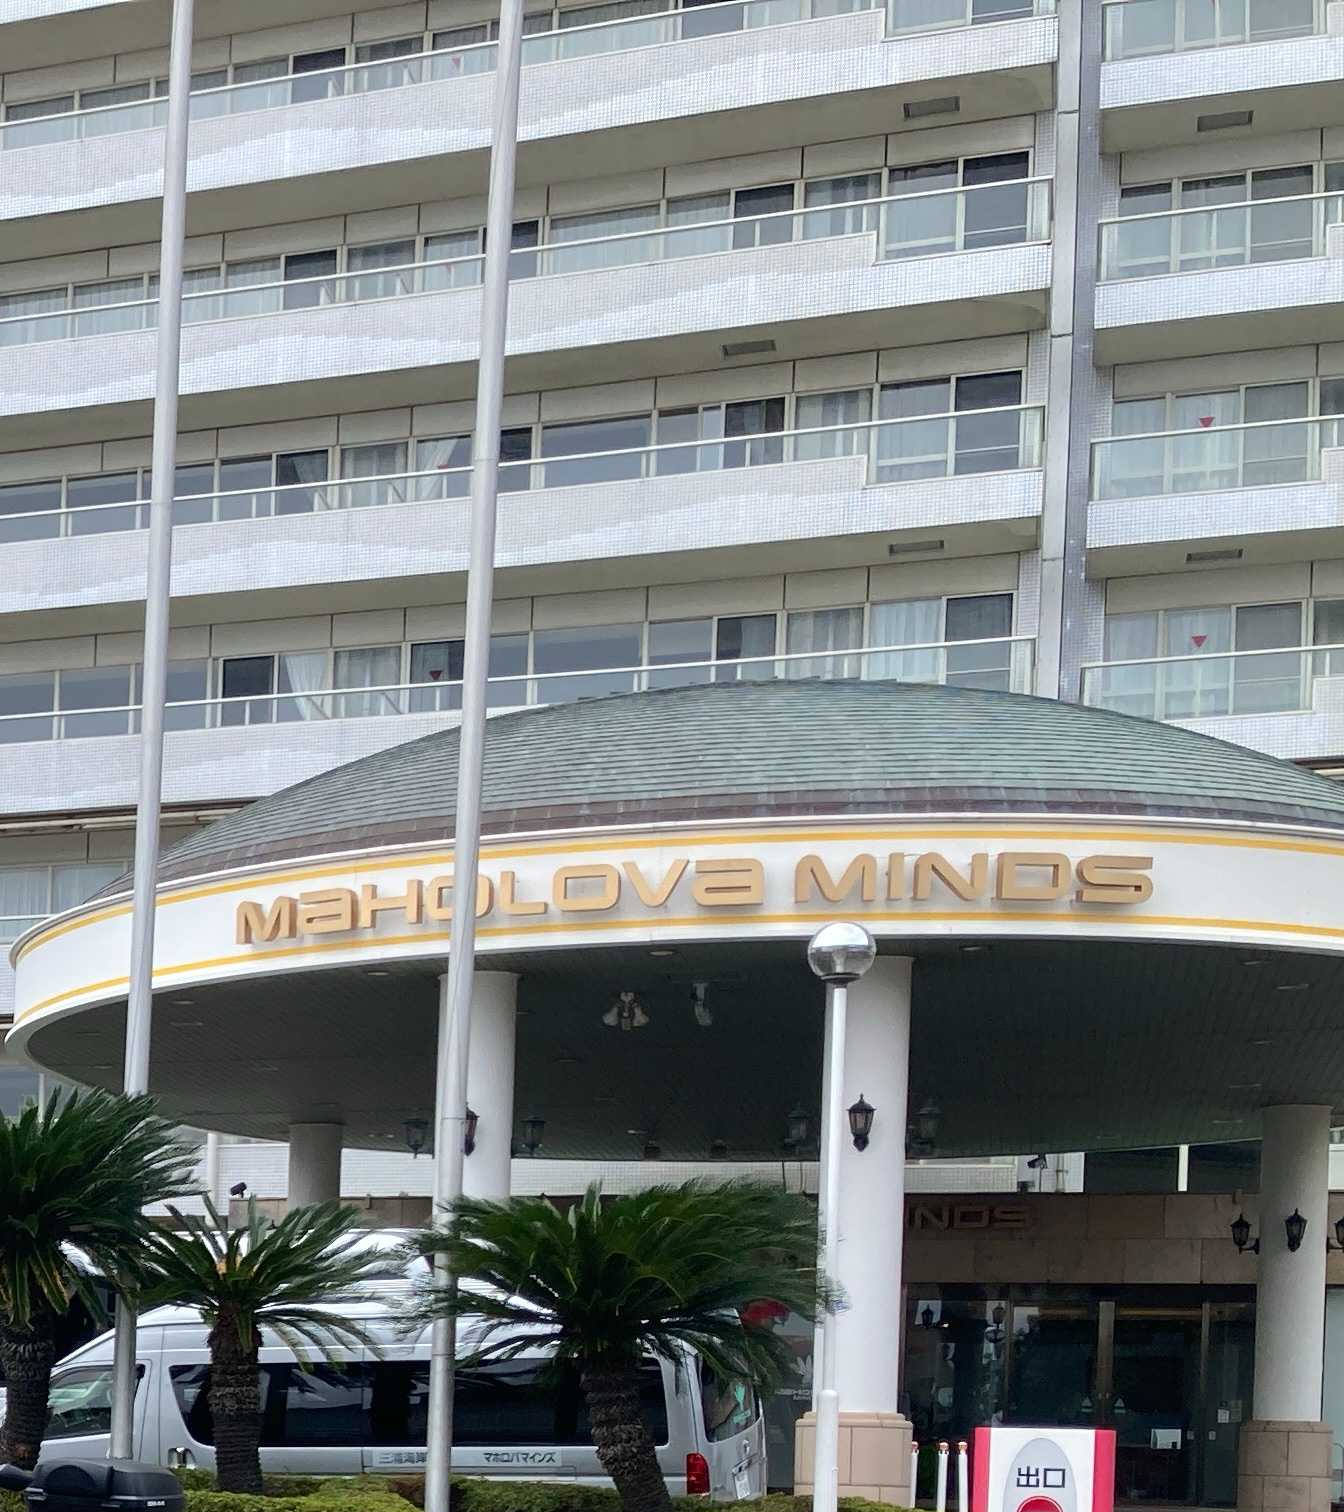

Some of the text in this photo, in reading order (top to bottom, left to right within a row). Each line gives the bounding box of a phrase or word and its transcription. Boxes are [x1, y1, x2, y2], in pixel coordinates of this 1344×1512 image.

[794, 852, 1154, 904] MINDS
[483, 1452, 555, 1463] マホロバマインズ
[1016, 1466, 1066, 1488] 出口
